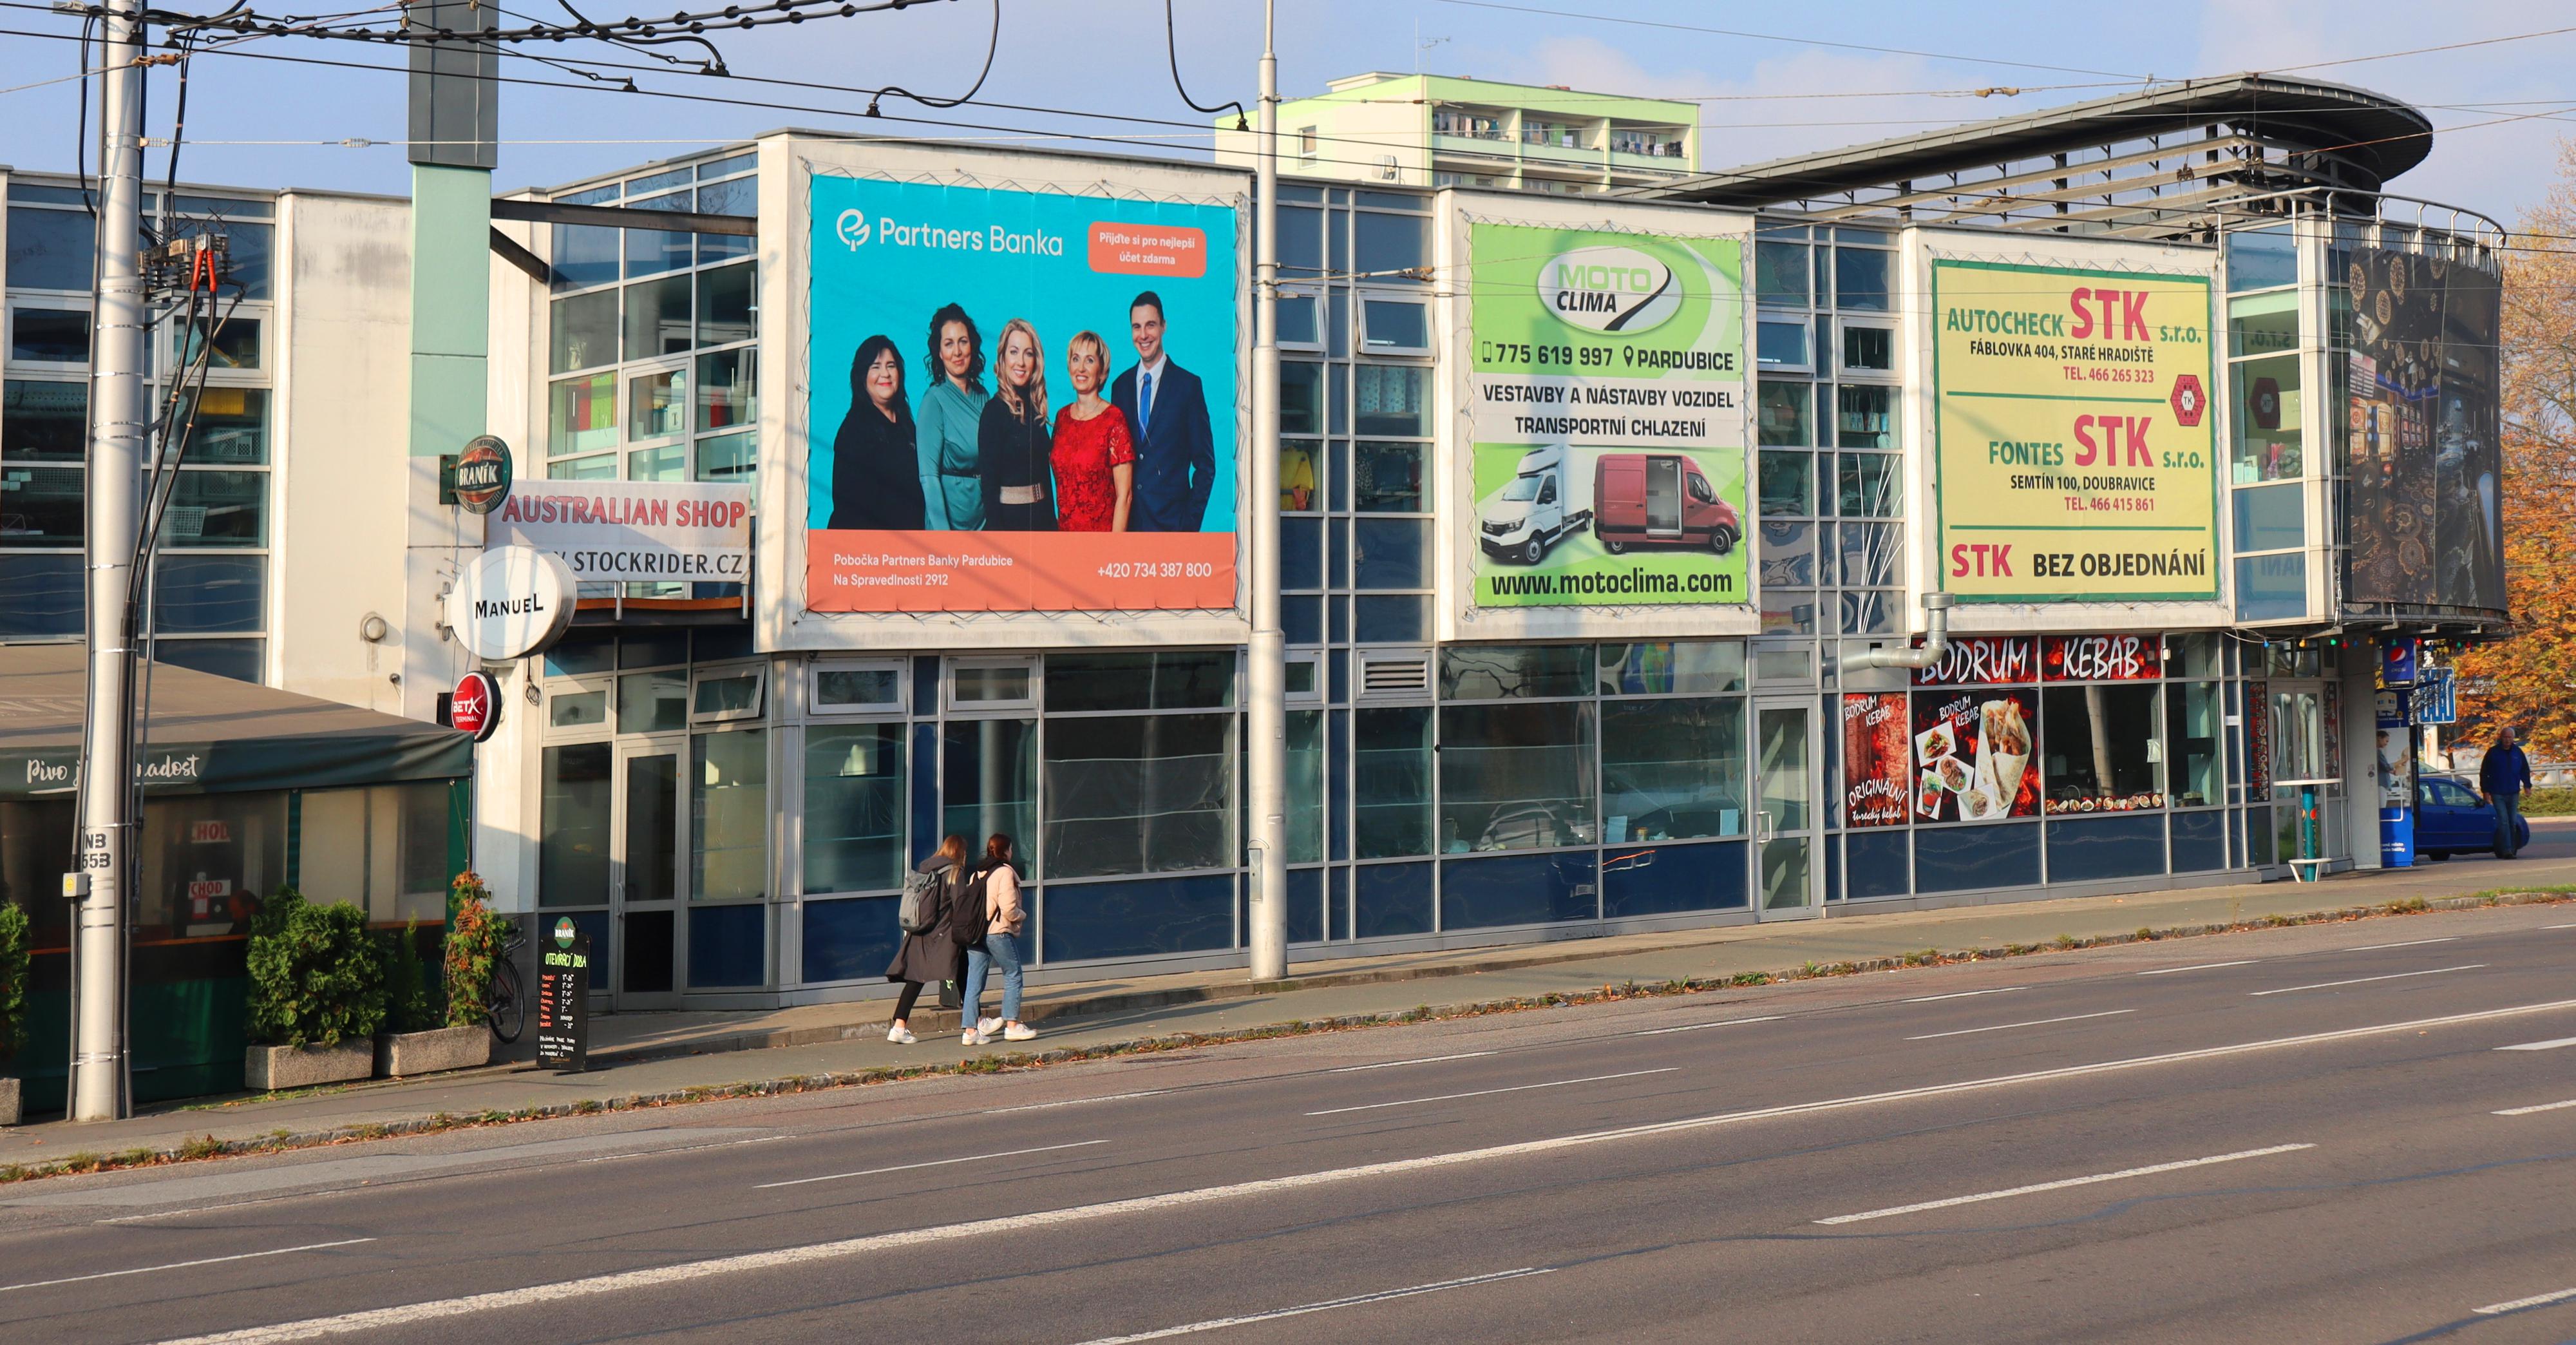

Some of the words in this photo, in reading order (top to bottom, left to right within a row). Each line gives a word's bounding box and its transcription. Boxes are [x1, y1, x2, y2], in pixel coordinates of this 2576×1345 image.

[880, 216, 983, 251] Partners
[989, 225, 1063, 256] Banka
[1099, 232, 1130, 245] Přijďte
[1132, 234, 1140, 245] si
[1142, 237, 1158, 247] pro
[1160, 236, 1195, 250] nejlepší
[1119, 251, 1141, 263] účet
[1142, 253, 1175, 265] zdarma
[1557, 263, 1652, 292] MOTO
[1556, 291, 1617, 313] CLIMA
[1947, 307, 2065, 338] AUTOCHECK
[2070, 287, 2151, 341] STK
[2160, 325, 2202, 343] s.r.o.
[1496, 343, 1531, 363] 775
[1538, 345, 1573, 365] 619
[1580, 347, 1613, 367] 997
[1638, 348, 1734, 371] PARDUBICE
[1971, 338, 2032, 358] FÁBLOVKA
[2034, 344, 2060, 361] 404,
[2061, 343, 2096, 361] STARÉ
[2098, 345, 2154, 363] HRADIŠTĚ
[2063, 365, 2086, 381] TEL.
[2088, 367, 2109, 382] 466
[2112, 368, 2132, 383] 265
[2134, 368, 2154, 383] 323
[1483, 383, 1566, 403] VESTAVBY
[1570, 386, 1581, 404] A
[1586, 385, 1668, 406] NÁSTAVBY
[1673, 390, 1734, 408] VOZIDEL
[2183, 396, 2193, 405] TK
[1515, 415, 1626, 435] TRANSPORTNÍ
[1631, 417, 1706, 437] CHLAZENÍ
[1989, 441, 2064, 466] FONTES
[2074, 414, 2154, 468] STK
[2163, 450, 2204, 469] s.r.o.
[459, 461, 498, 486] BRANÍK
[2011, 472, 2054, 490] SEMTÍN
[2057, 475, 2081, 493] 100,
[2083, 475, 2155, 491] DOUBRAVICE
[502, 494, 668, 526] AUSTRALIAN
[676, 499, 746, 528] SHOP
[2065, 496, 2087, 511] TEL.
[2090, 497, 2110, 511] 466
[2113, 497, 2133, 511] 415
[2135, 497, 2154, 511] 861
[553, 550, 743, 575] STOCKRIDER.CZ
[834, 553, 879, 566] Pobočka
[882, 554, 925, 566] Partners
[929, 555, 959, 569] Banky
[962, 555, 1013, 567] Pardubice
[1097, 562, 1130, 578] +420
[1134, 562, 1157, 578] 734
[1159, 562, 1183, 578] 387
[1186, 562, 1212, 578] 800
[1951, 543, 2013, 578] STK
[2033, 553, 2075, 577] BEZ
[2080, 548, 2205, 577] OBJEDNÁNÍ
[834, 573, 848, 586] Na
[851, 573, 922, 587] Spravedlnosti
[925, 574, 949, 586] 2912
[1491, 567, 1732, 595] www.motoclima.com
[2063, 636, 2139, 680] KEBAB
[1844, 695, 1877, 721] BODRUM
[1866, 705, 1891, 727] KEBAB
[1939, 695, 1971, 721] BODRUM
[1955, 706, 1979, 727] KEBAB
[27, 759, 68, 783] Pivo
[1849, 777, 1908, 806] ORIGINÁLNÍ
[1852, 807, 1880, 825] turecký
[1882, 805, 1901, 819] kebab
[86, 833, 106, 849] NB
